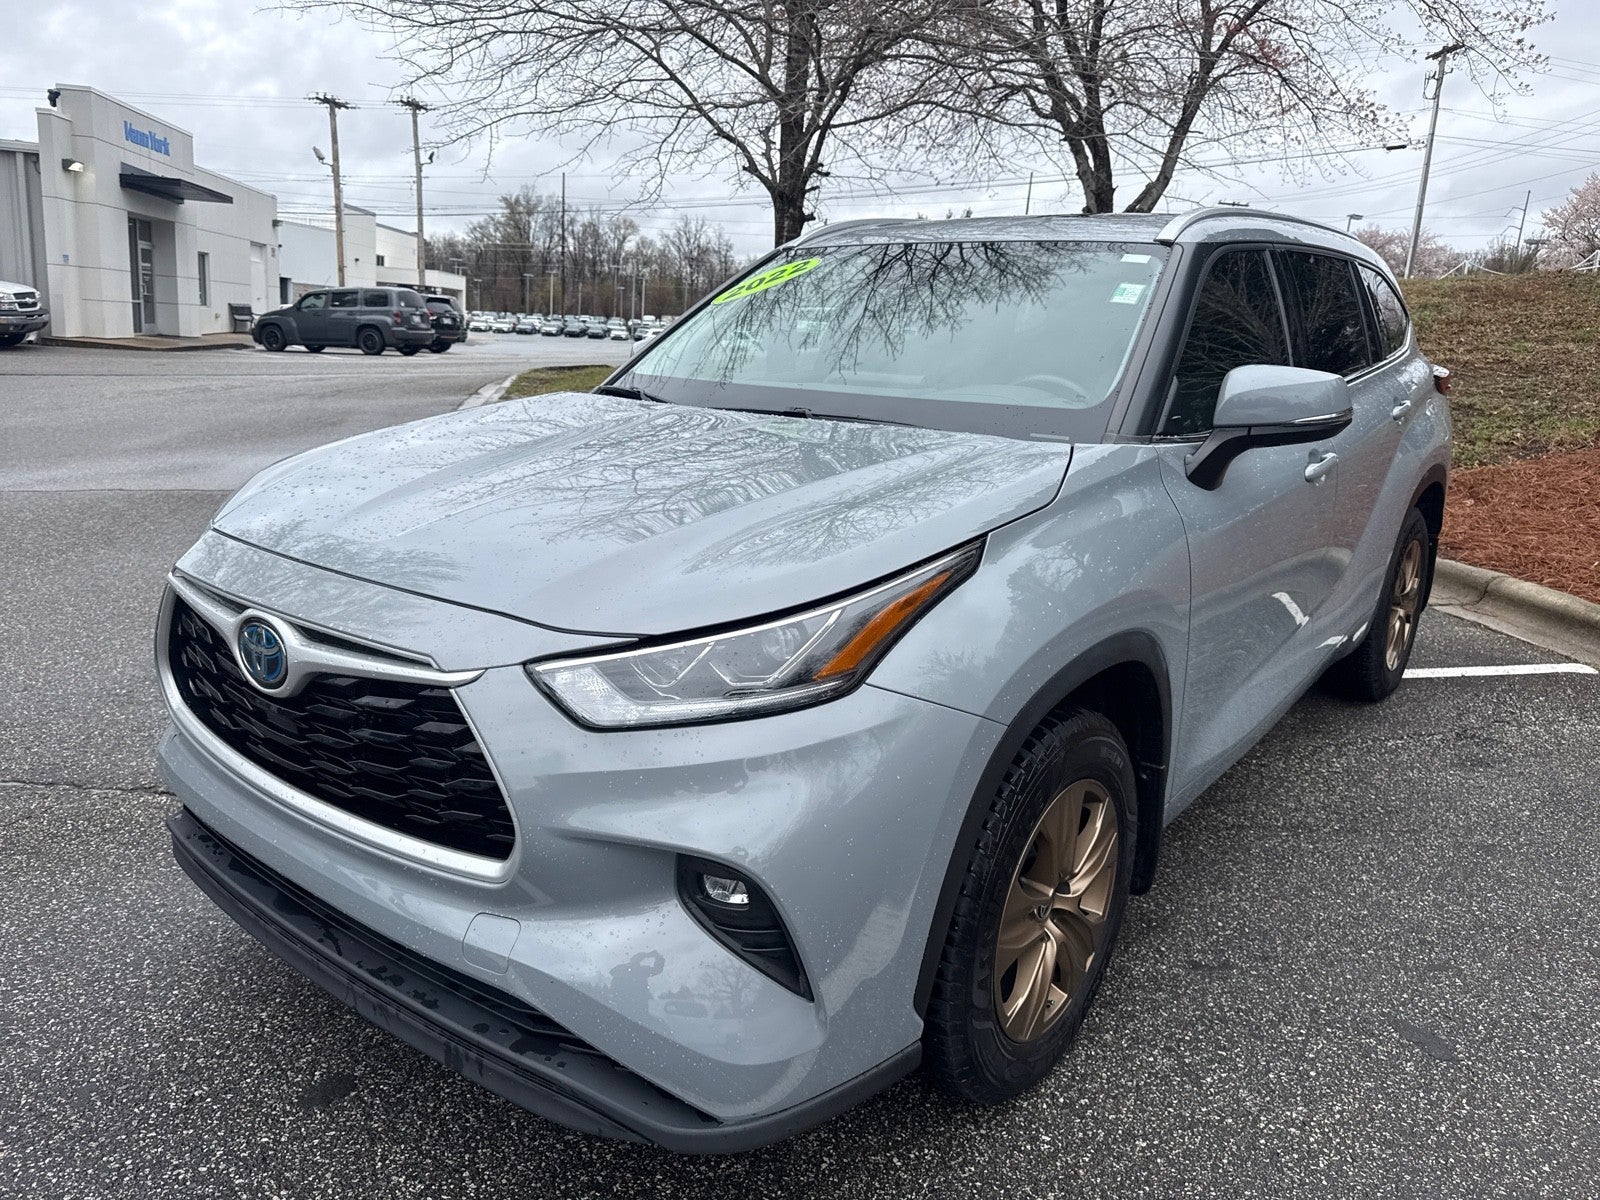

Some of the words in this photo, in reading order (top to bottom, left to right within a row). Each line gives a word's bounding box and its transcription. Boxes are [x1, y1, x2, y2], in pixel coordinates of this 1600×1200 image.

[123, 120, 149, 149] Vann
[148, 130, 170, 157] York
[721, 260, 811, 302] 2022
